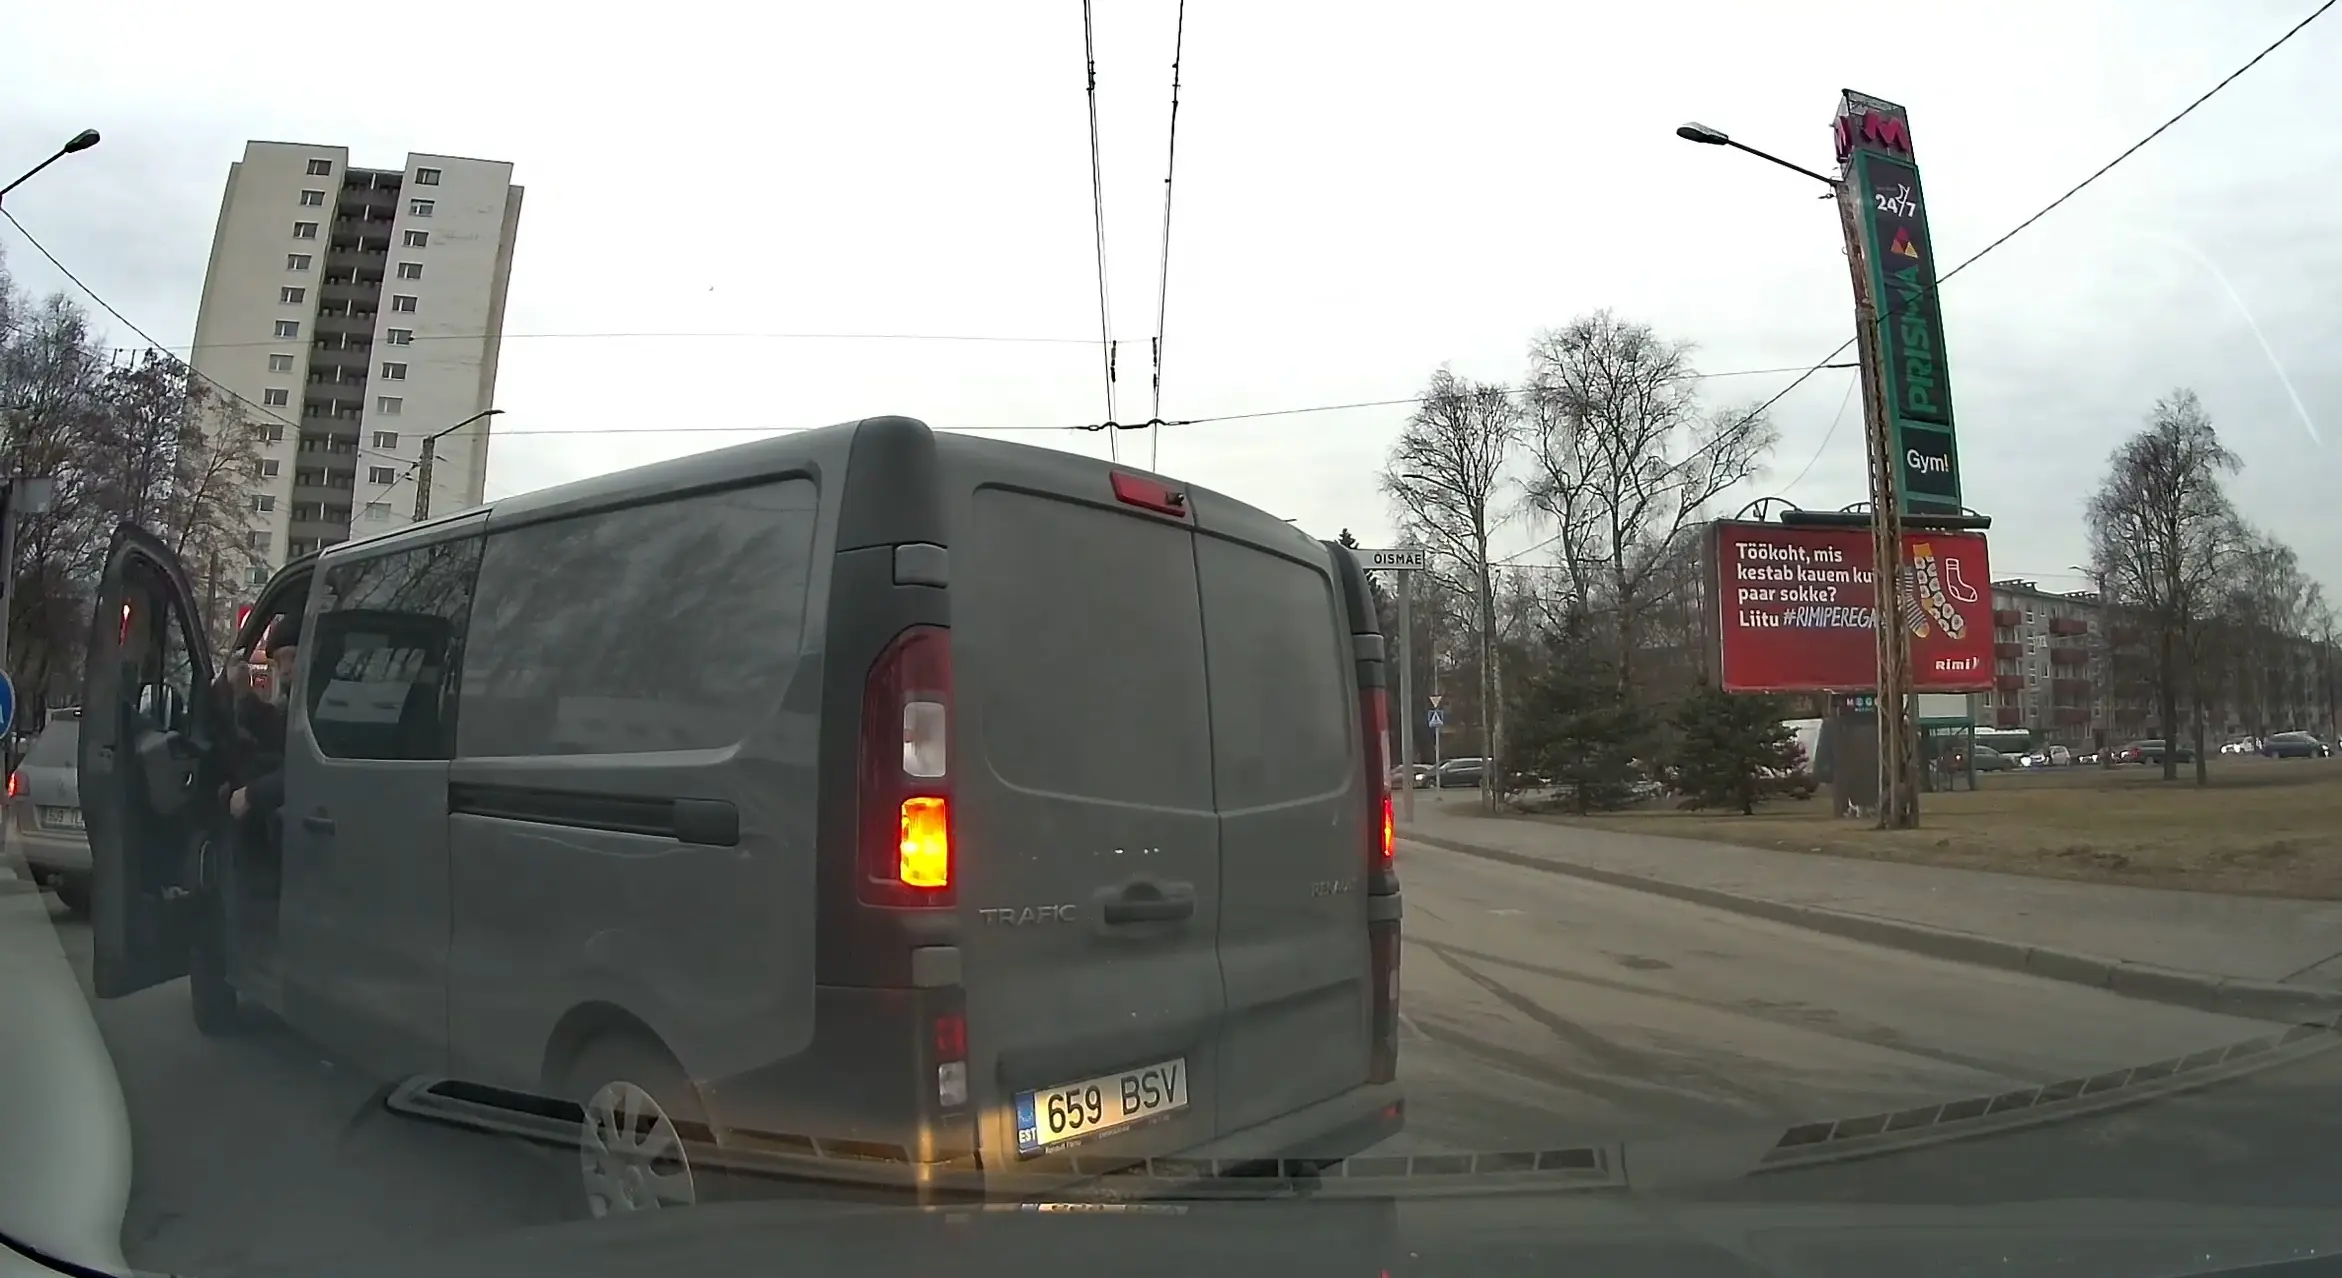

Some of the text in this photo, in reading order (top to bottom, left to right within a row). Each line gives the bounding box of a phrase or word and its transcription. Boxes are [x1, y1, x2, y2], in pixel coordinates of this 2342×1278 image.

[1906, 449, 1950, 473] Gym!
[1735, 542, 1843, 564] Töökoht, mis
[1736, 563, 1876, 583] kestab kauem ku
[1738, 585, 1837, 604] paar sokke?
[1739, 610, 1779, 628] Liitu
[978, 904, 1078, 926] TRAFIC
[1046, 1064, 1179, 1134] 659 BSV
[1018, 1126, 1037, 1144] EST
